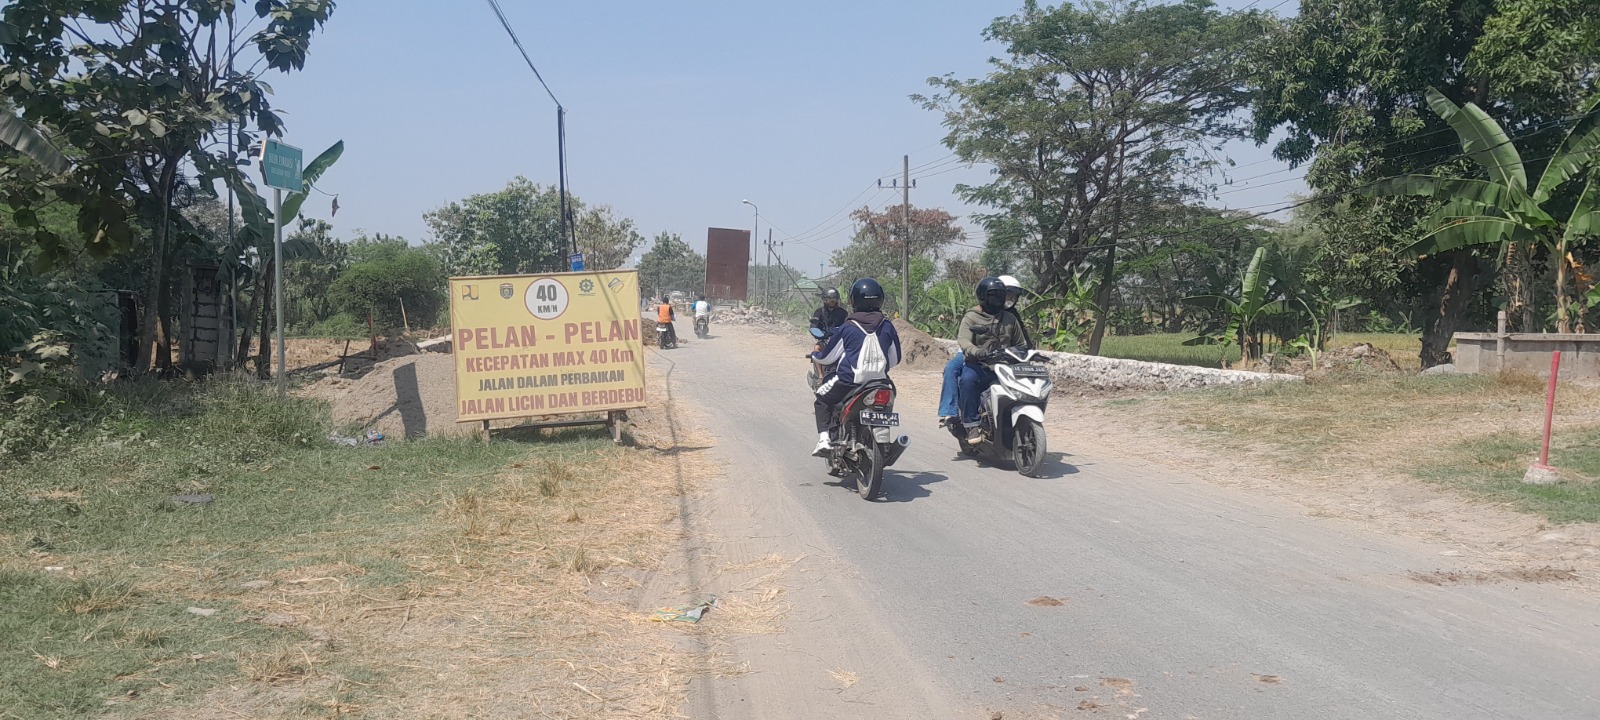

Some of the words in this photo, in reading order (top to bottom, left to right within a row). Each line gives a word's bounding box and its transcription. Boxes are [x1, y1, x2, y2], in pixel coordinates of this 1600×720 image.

[536, 284, 557, 301] 40
[537, 304, 558, 314] KM/H
[458, 325, 536, 351] PELAN
[564, 319, 638, 344] PELAN
[465, 353, 549, 373] KECEPATAN
[552, 350, 586, 367] MAX
[589, 349, 608, 364] 40
[611, 348, 634, 363] Km
[478, 377, 515, 391] JALAN
[517, 374, 558, 388] DALAM
[560, 369, 625, 385] PERBAIKAN
[460, 397, 505, 415] JALAN
[508, 394, 544, 412] LICIN
[548, 391, 578, 408] DAN
[581, 387, 644, 406] BERDEBU
